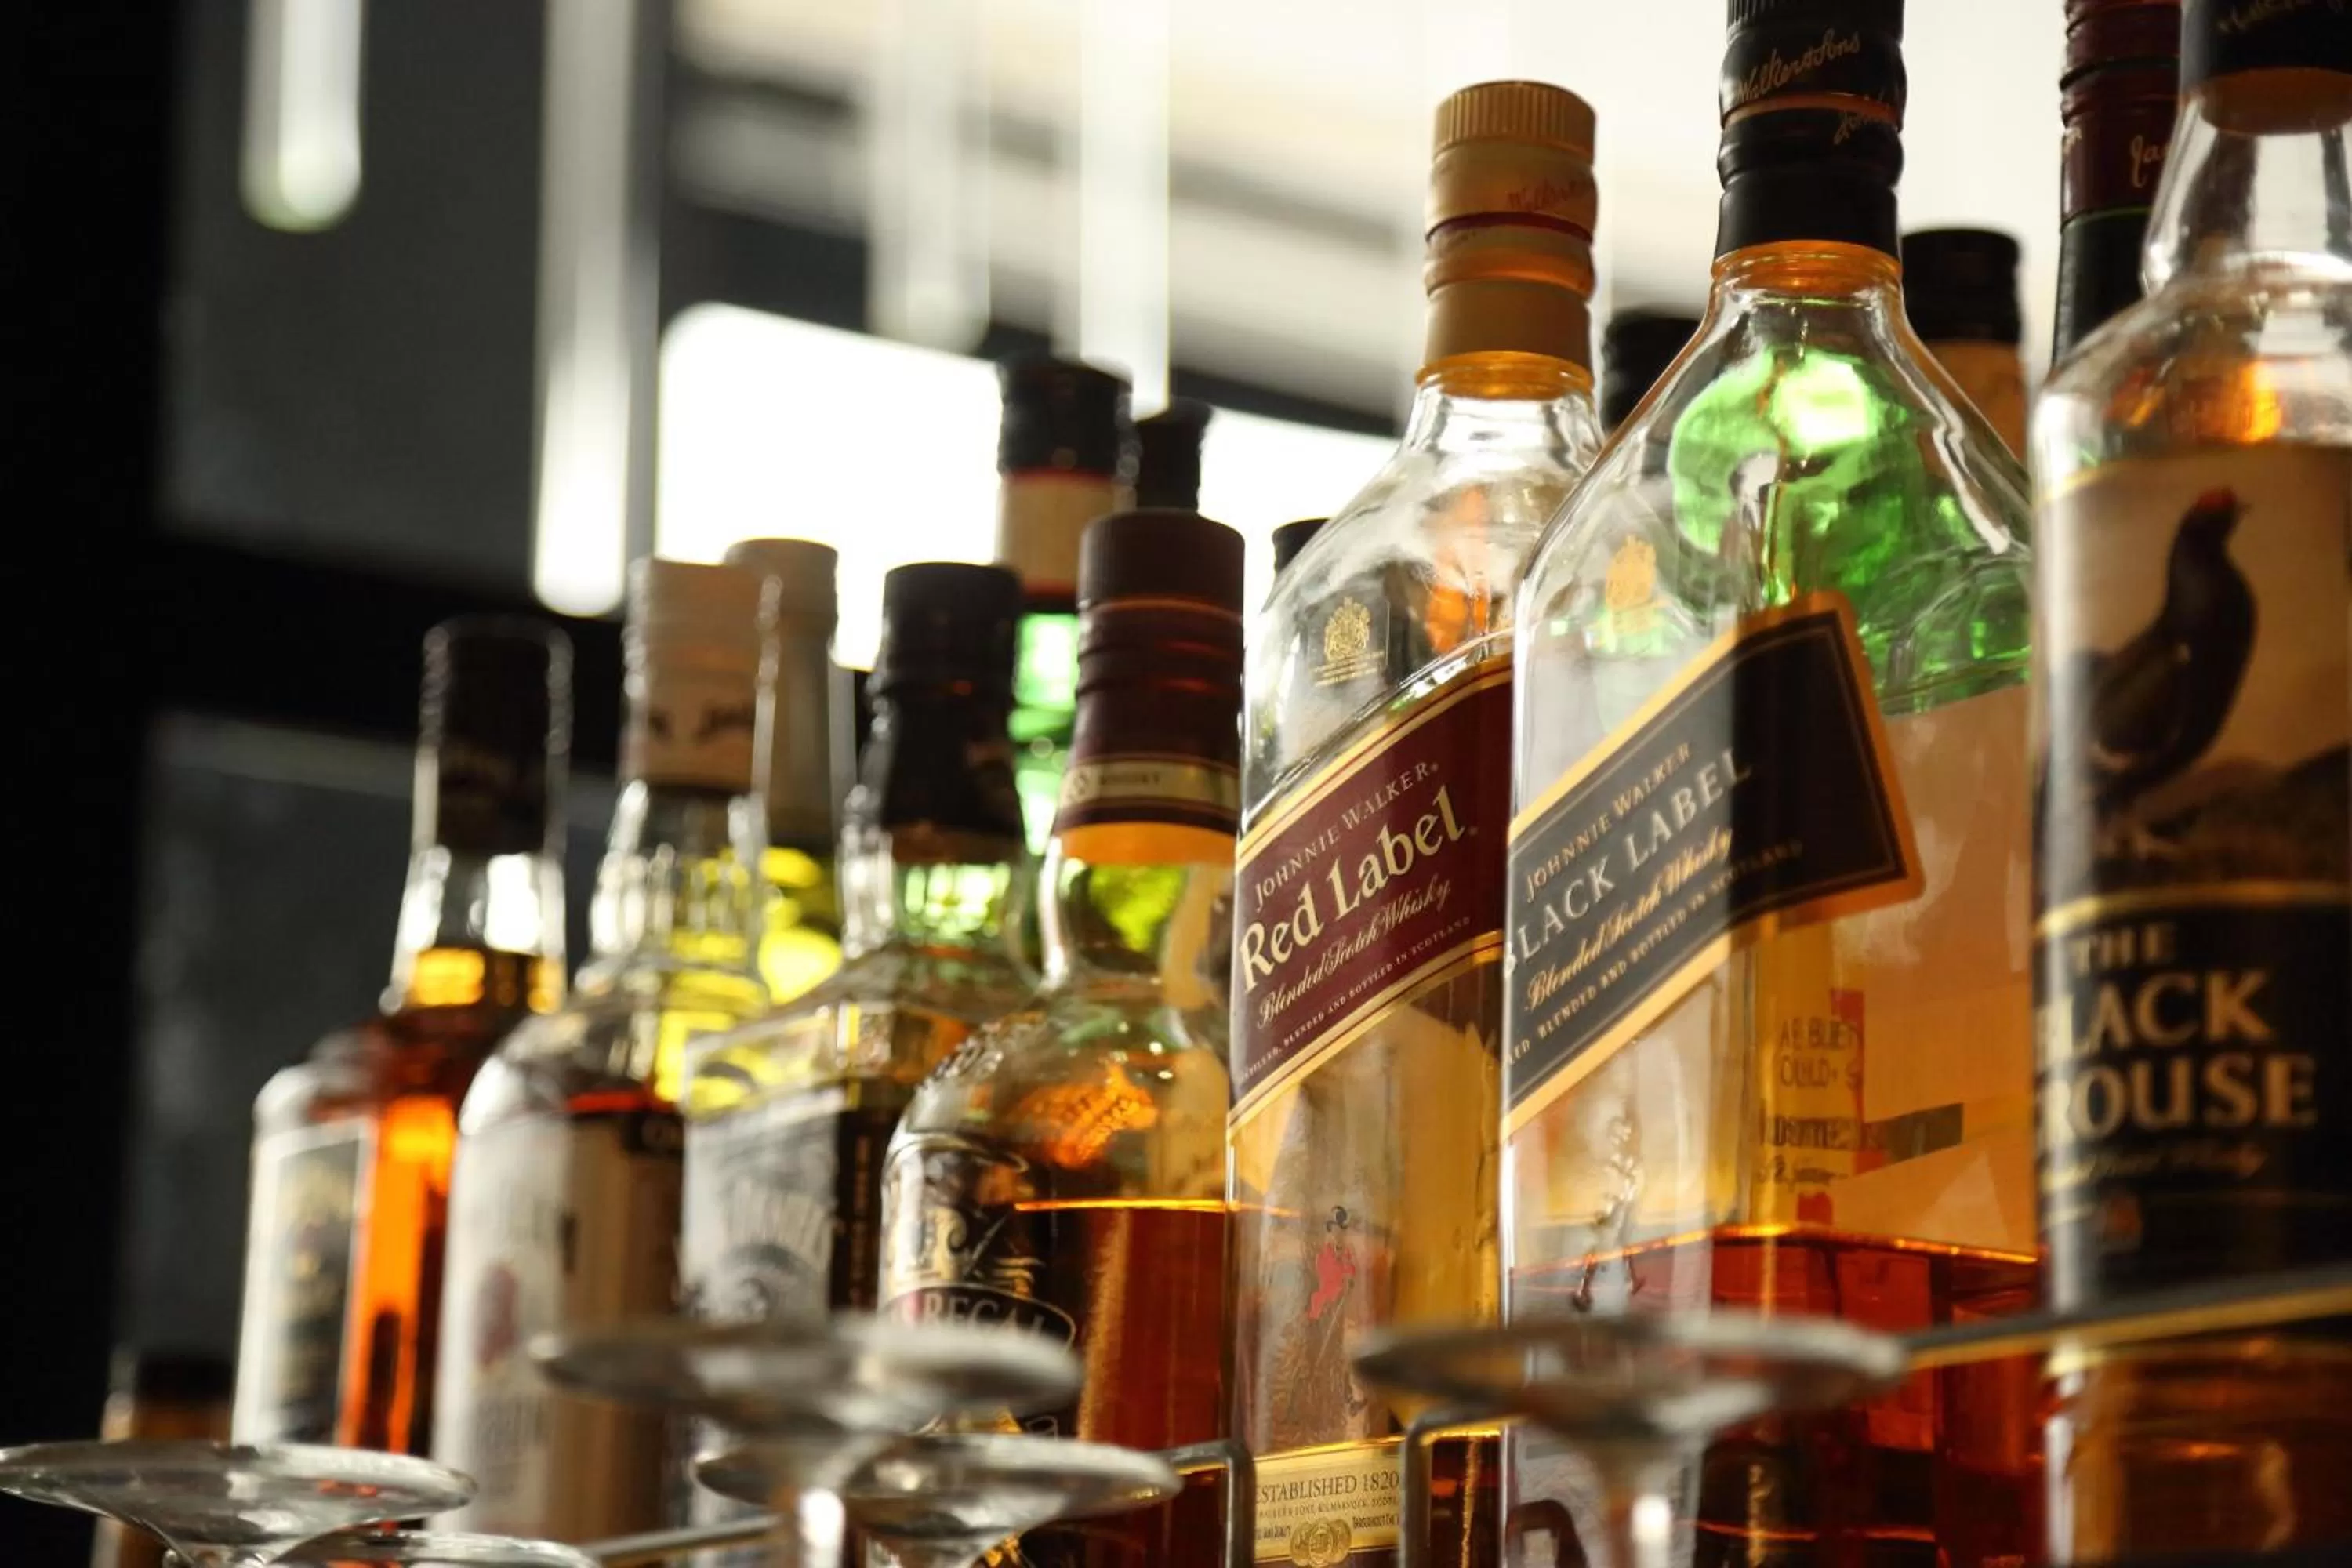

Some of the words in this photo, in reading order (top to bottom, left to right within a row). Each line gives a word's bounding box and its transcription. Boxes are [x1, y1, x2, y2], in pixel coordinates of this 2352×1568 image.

[1255, 824, 1341, 913] JOHNNIE
[1341, 761, 1431, 831] WALKER
[1526, 811, 1612, 904] JOHNNIE
[1611, 742, 1690, 818] WALKER
[1624, 747, 1753, 873] LABEL
[1239, 880, 1325, 994] Red
[1326, 784, 1465, 921] Label
[1257, 953, 1327, 1029] Blended
[1325, 912, 1381, 976] Scotch
[1378, 872, 1450, 935] Whisky
[2069, 921, 2175, 977] THE
[1283, 1011, 1325, 1047] BLENDED
[1327, 995, 1347, 1015] AND
[1348, 962, 1393, 998] BOTTLED
[1396, 952, 1407, 965] IN
[1412, 916, 1470, 956] SCOTLAND
[1524, 923, 1607, 1011] Blended
[1537, 984, 1597, 1040] BLENDED
[1599, 959, 1627, 989] AND
[1363, 1471, 1399, 1492] 1820
